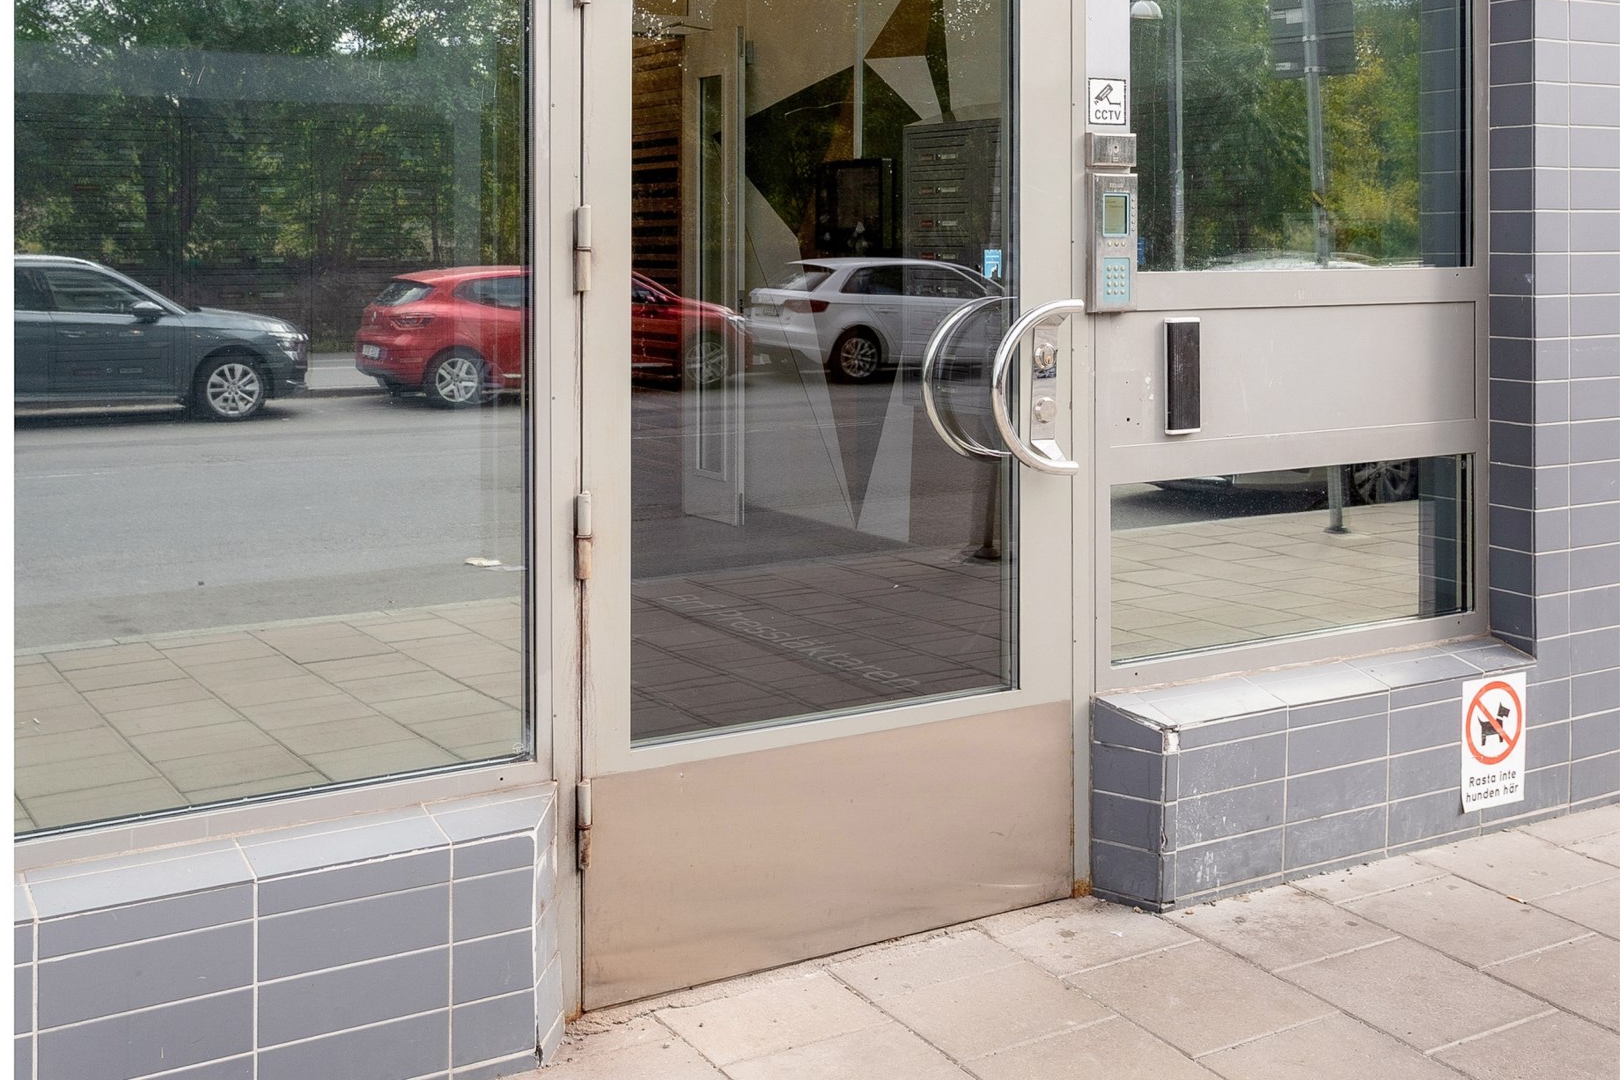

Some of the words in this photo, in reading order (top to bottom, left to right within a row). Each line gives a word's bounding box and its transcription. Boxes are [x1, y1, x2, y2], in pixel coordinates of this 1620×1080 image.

[1094, 109, 1121, 121] CCTV
[659, 594, 727, 610] Brf
[1469, 773, 1496, 788] Rasta
[1500, 770, 1517, 781] inte
[1466, 788, 1500, 803] hunden
[1503, 783, 1519, 795] här
